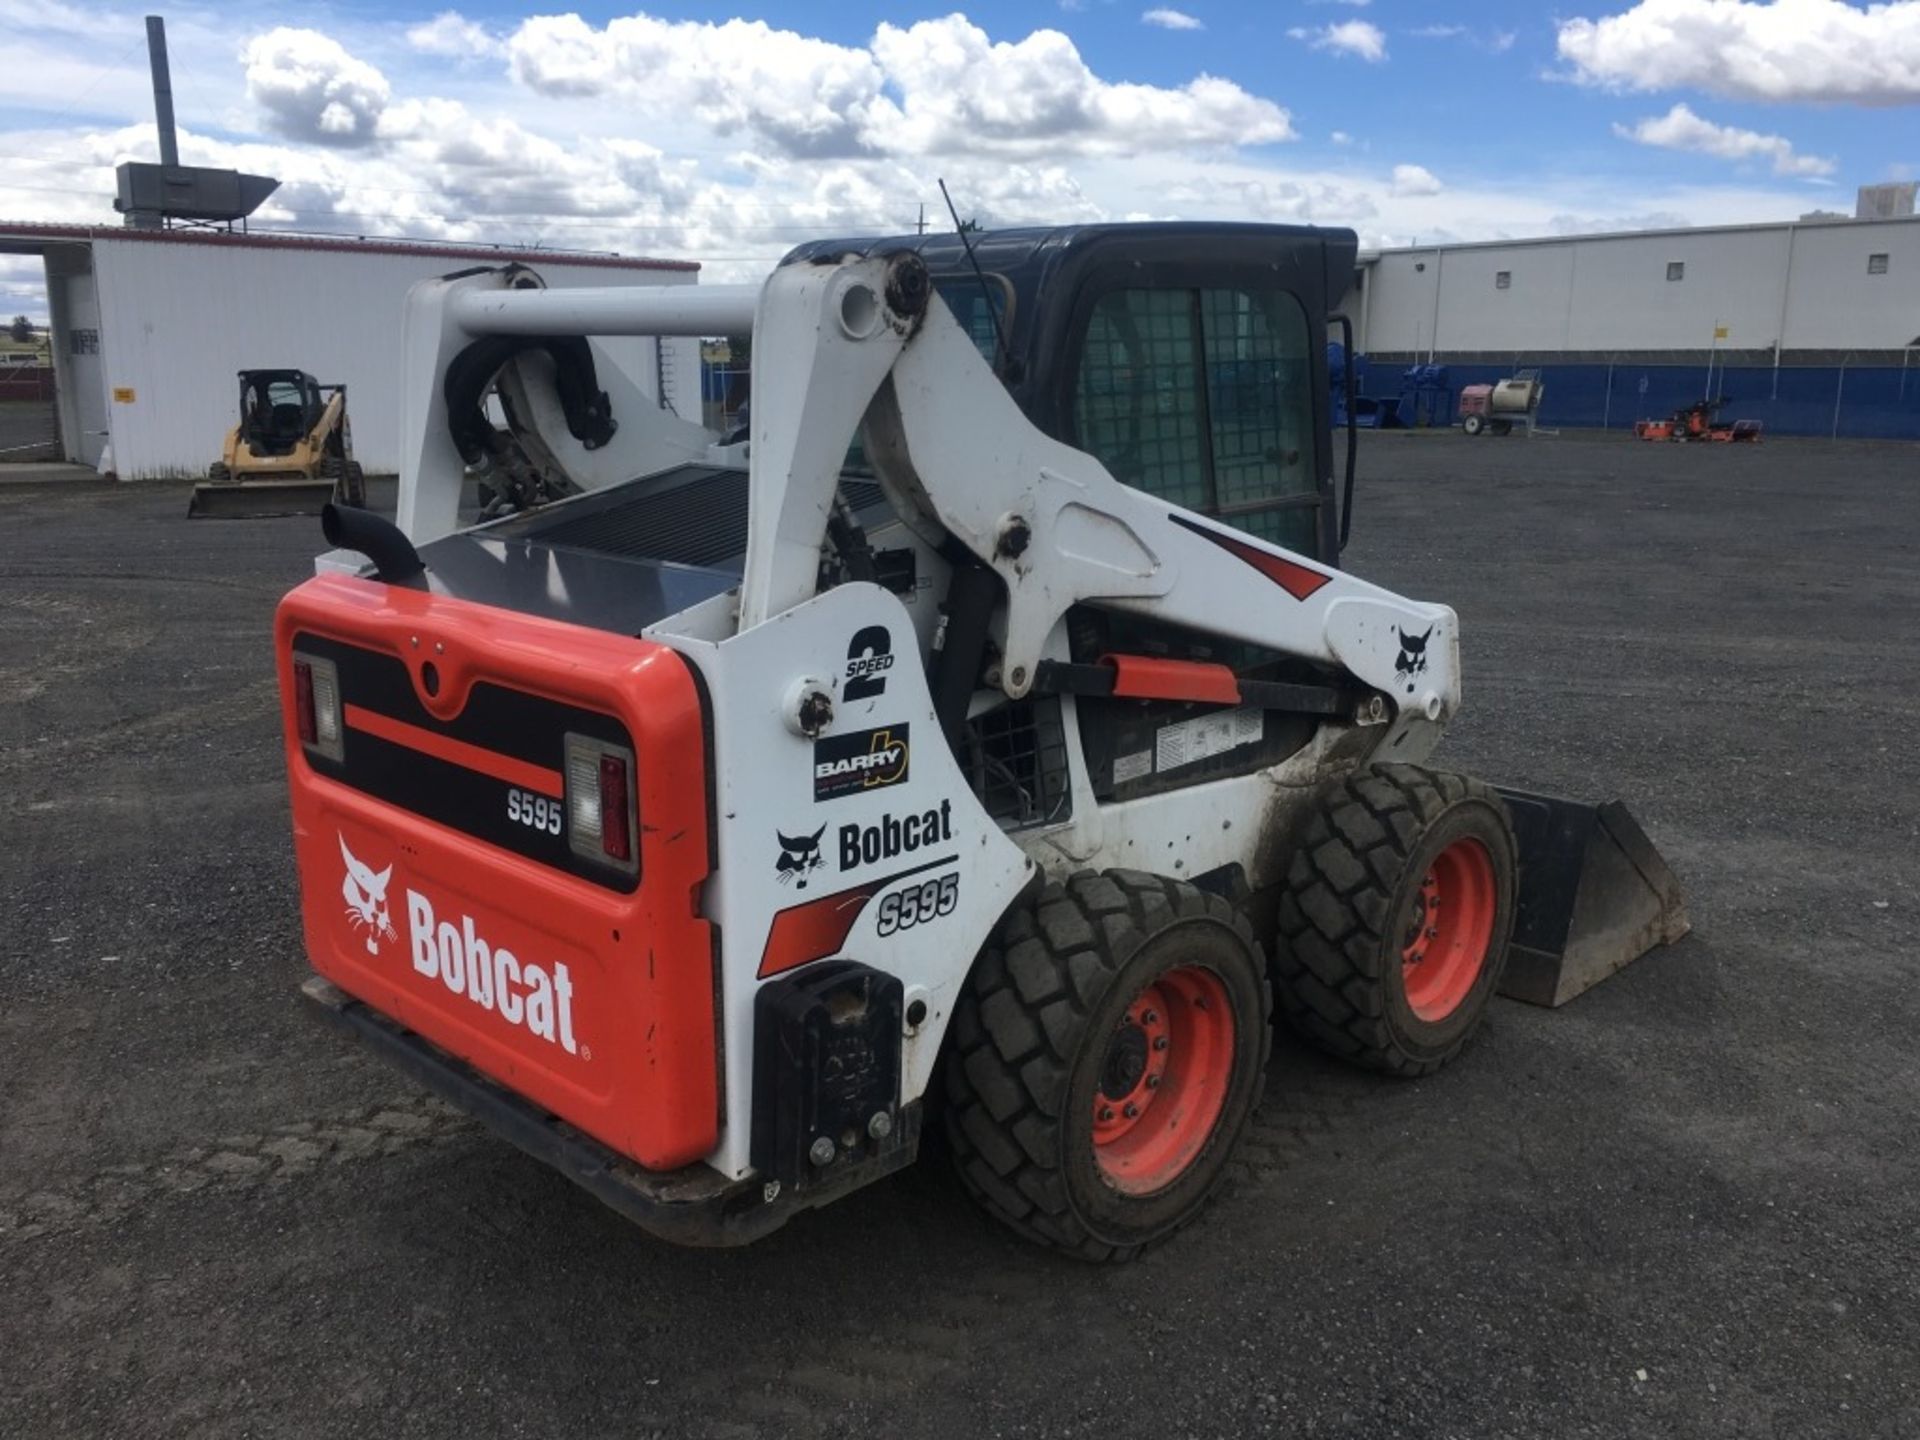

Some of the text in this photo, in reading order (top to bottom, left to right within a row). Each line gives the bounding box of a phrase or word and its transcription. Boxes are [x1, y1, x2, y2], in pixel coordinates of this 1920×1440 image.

[842, 625, 891, 703] 2
[845, 654, 895, 678] SPEED
[815, 747, 900, 779] BARRY
[507, 789, 562, 836] S595
[839, 799, 952, 873] Bobcat
[877, 871, 960, 938] S595
[406, 888, 576, 1056] Bobcat
